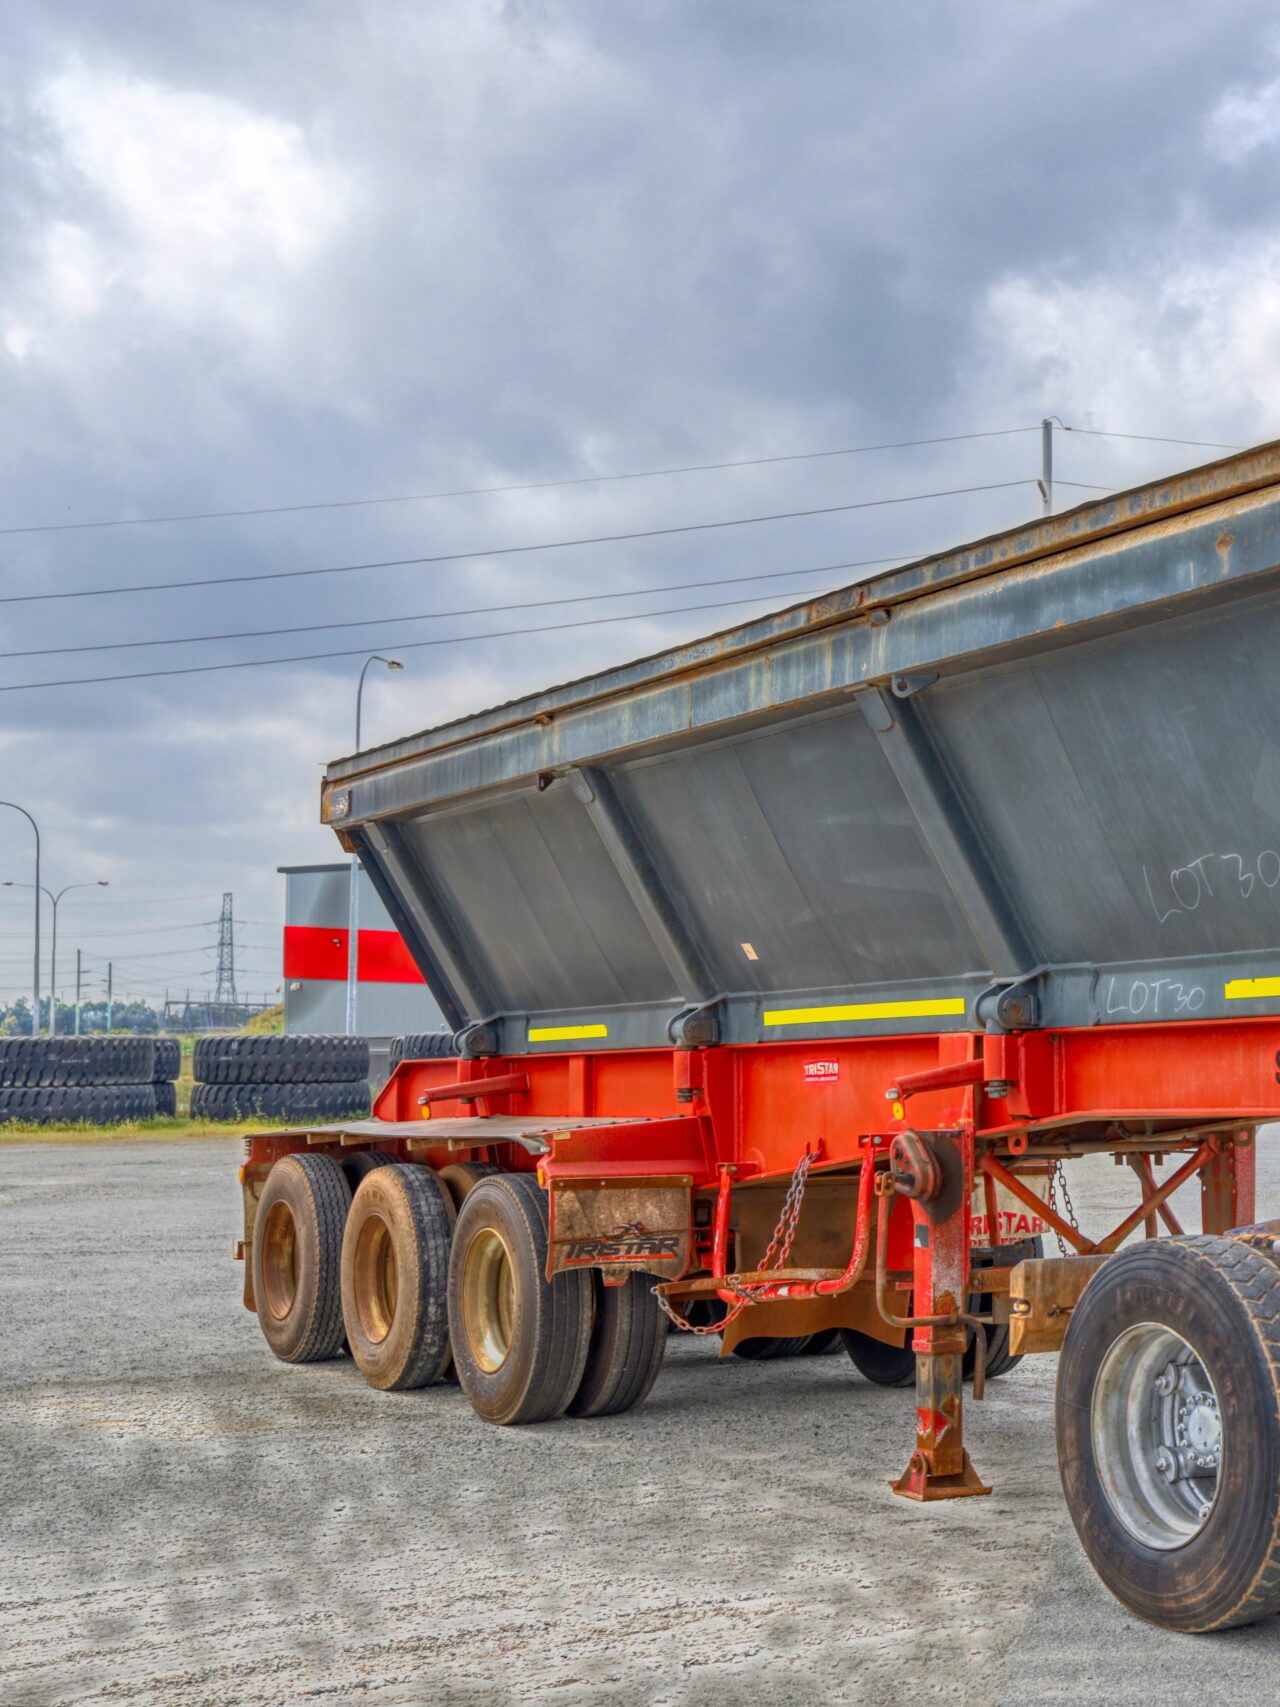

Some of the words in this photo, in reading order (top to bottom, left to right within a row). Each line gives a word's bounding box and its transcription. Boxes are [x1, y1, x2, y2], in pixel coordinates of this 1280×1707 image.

[1142, 853, 1215, 923] LOT
[1220, 850, 1280, 898] 30
[1106, 977, 1172, 1014] LOT
[1168, 983, 1206, 1012] 30
[803, 1061, 839, 1075] TRISTAR
